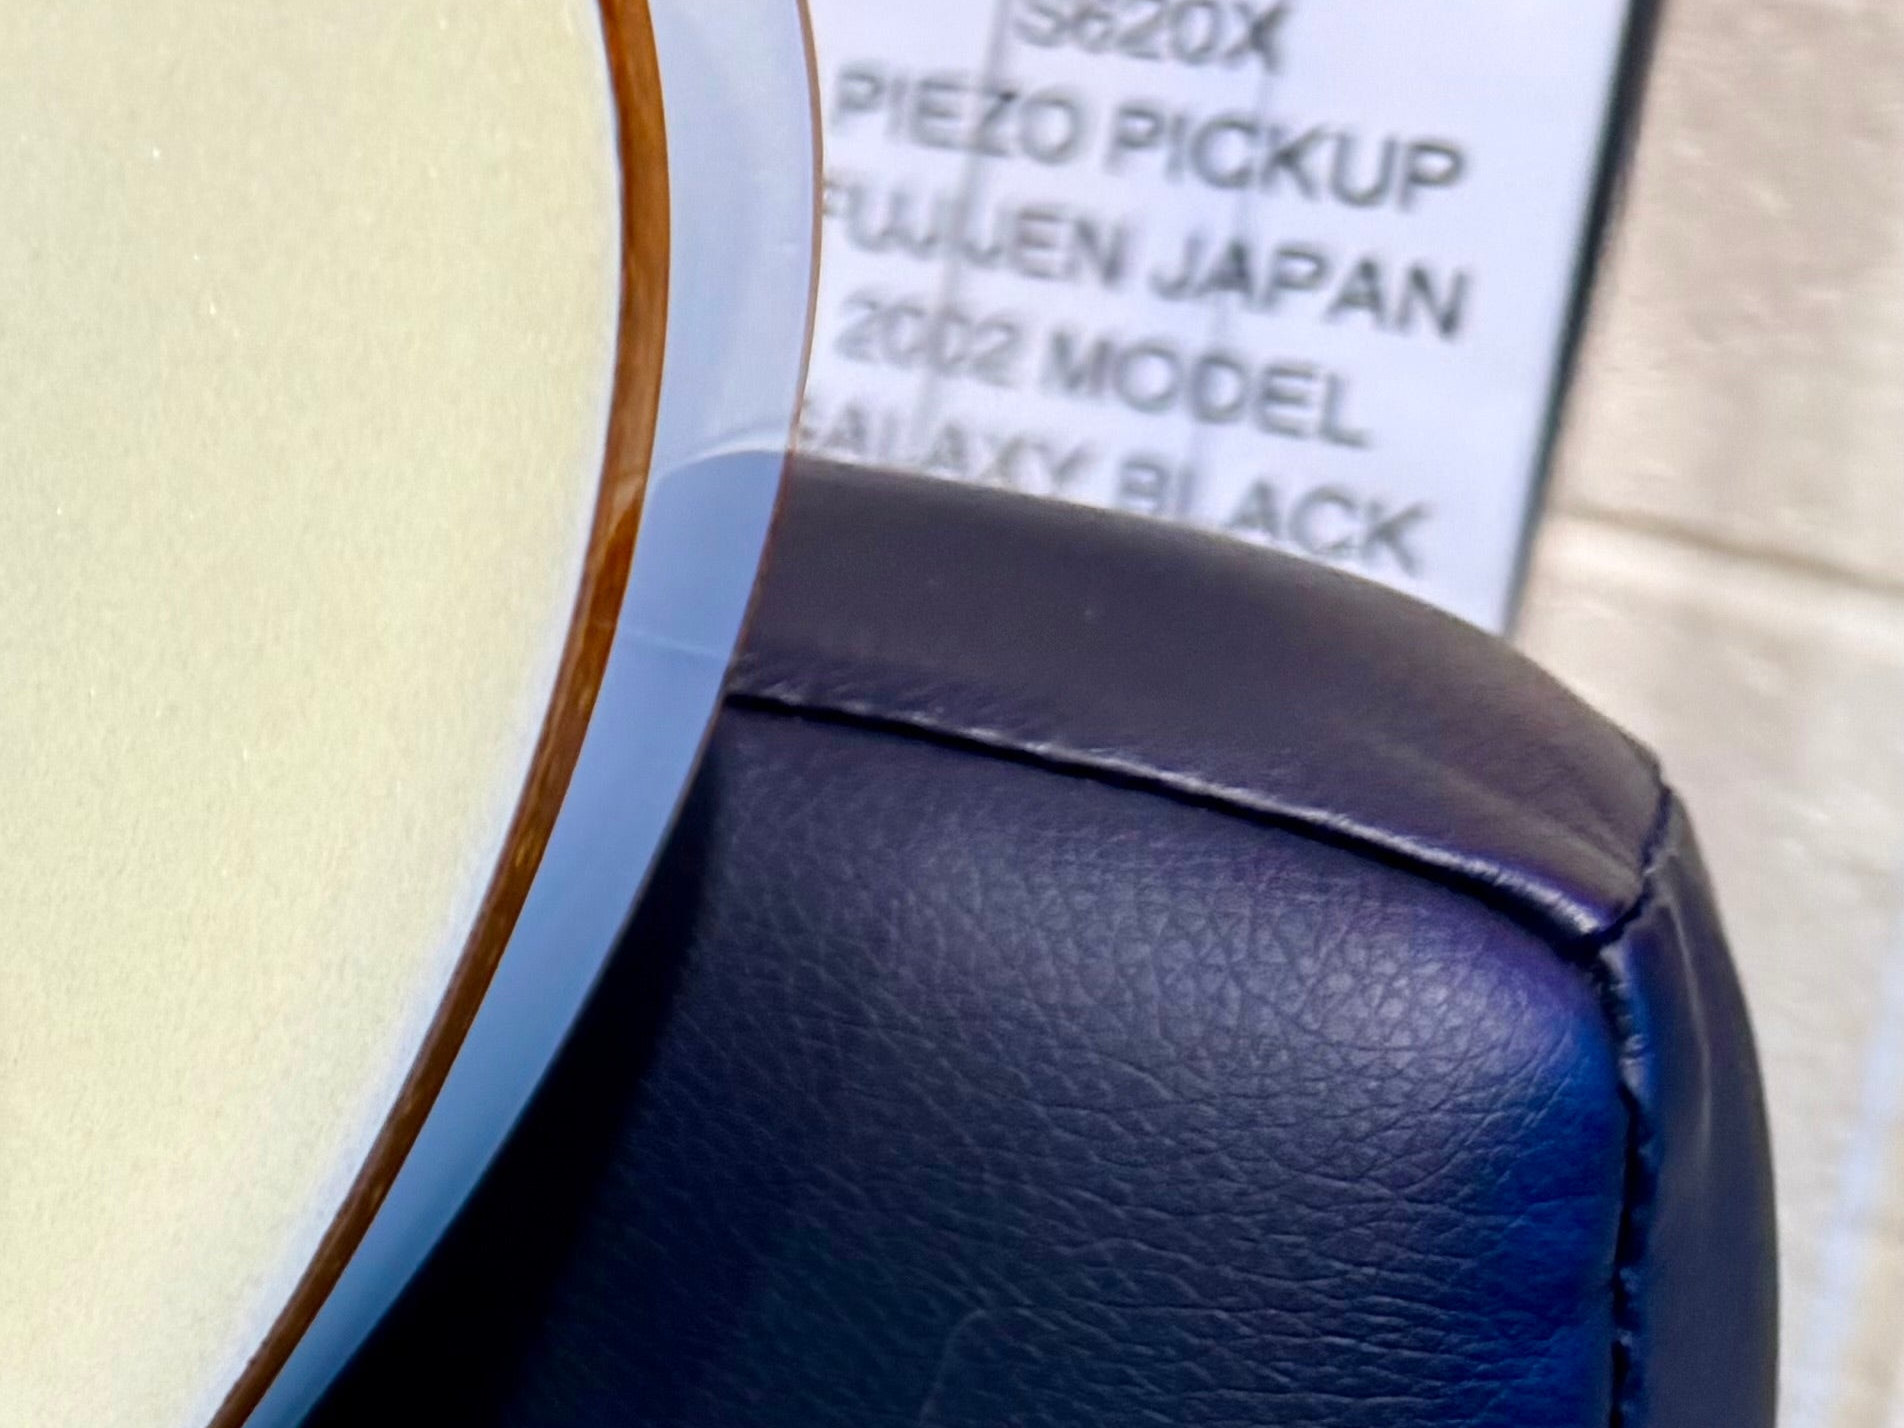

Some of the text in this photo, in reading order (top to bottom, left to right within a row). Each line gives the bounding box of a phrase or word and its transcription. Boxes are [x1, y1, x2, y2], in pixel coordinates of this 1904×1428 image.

[832, 61, 1469, 211] PIEZO PICKUP
[1148, 237, 1472, 341] JAPAN
[833, 290, 1369, 449] 2002 MODEL
[1115, 449, 1430, 577] BLACK
